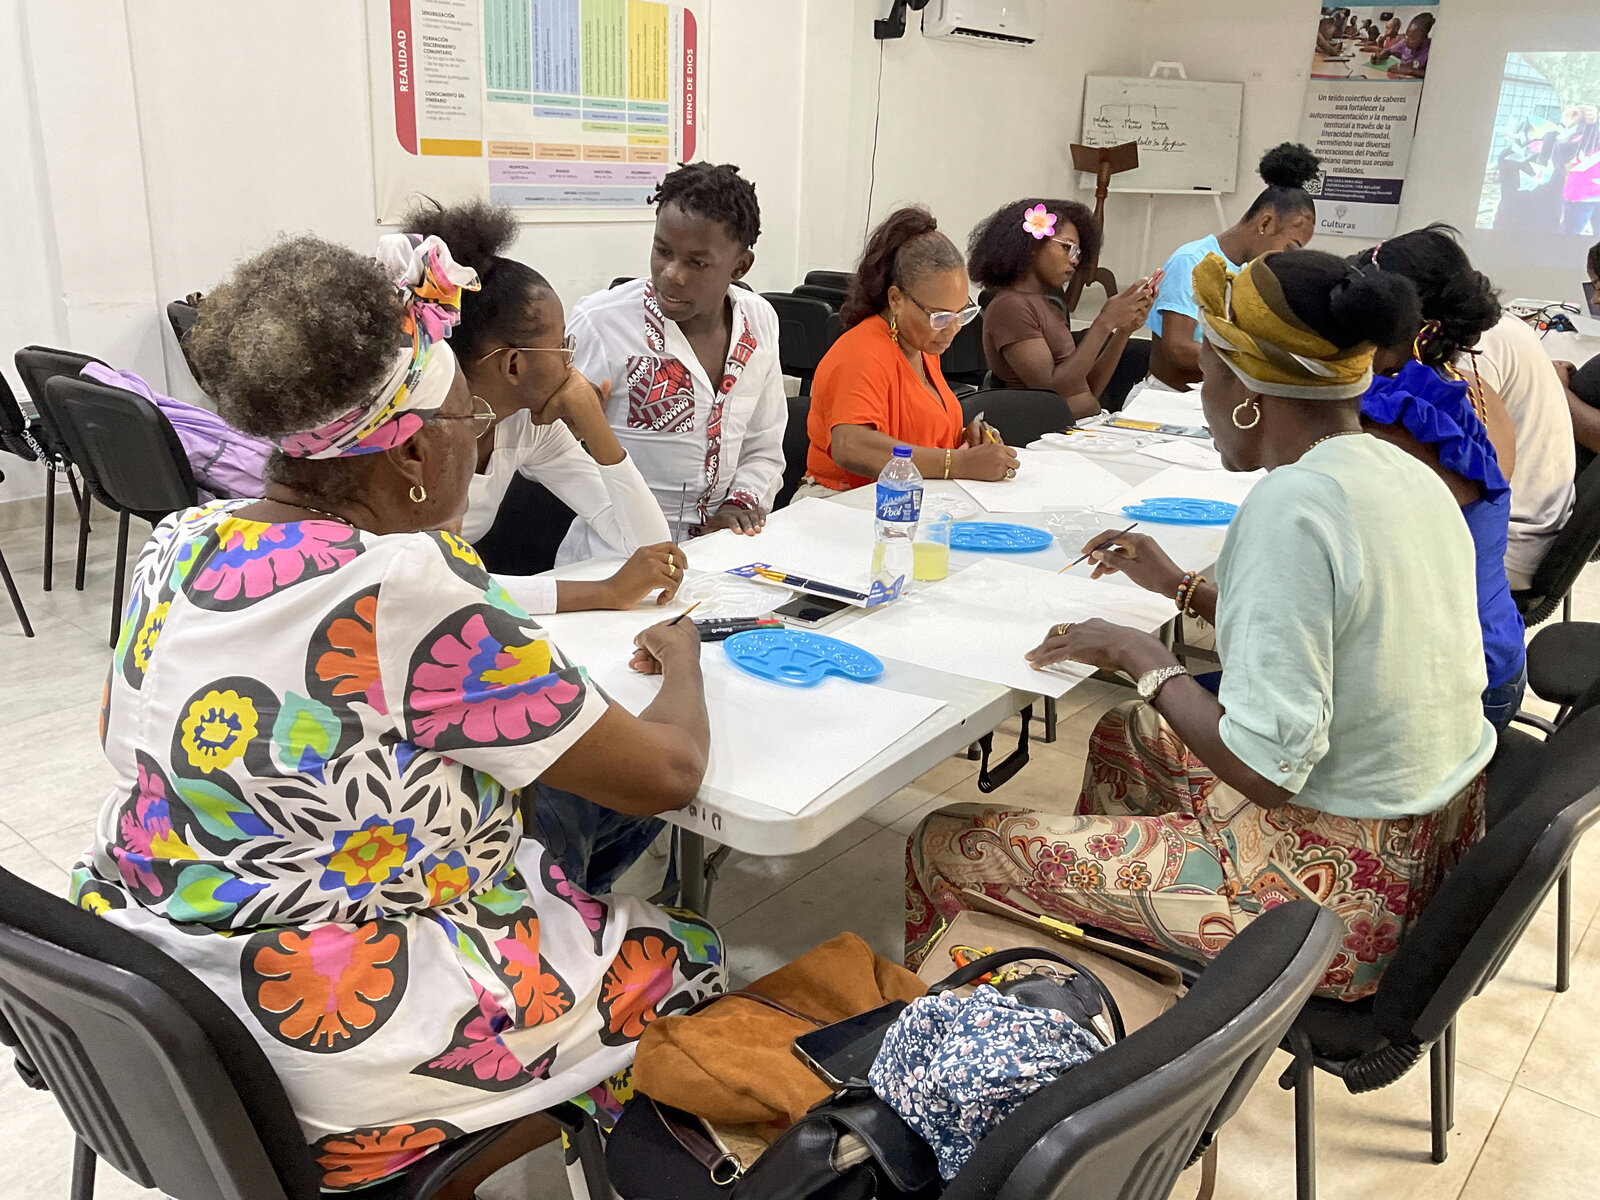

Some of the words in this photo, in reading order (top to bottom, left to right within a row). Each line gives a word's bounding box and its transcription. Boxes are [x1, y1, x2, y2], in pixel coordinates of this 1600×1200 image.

[397, 29, 409, 93] REALIDAD
[686, 75, 694, 94] DE
[1309, 112, 1368, 121] autorrepresentación
[1317, 139, 1352, 147] permitiendo
[1366, 140, 1391, 148] diversas
[1314, 148, 1354, 156] generaciones
[1366, 149, 1390, 157] Pacífico
[1321, 220, 1356, 229] Culturas
[883, 505, 903, 517] Pool
